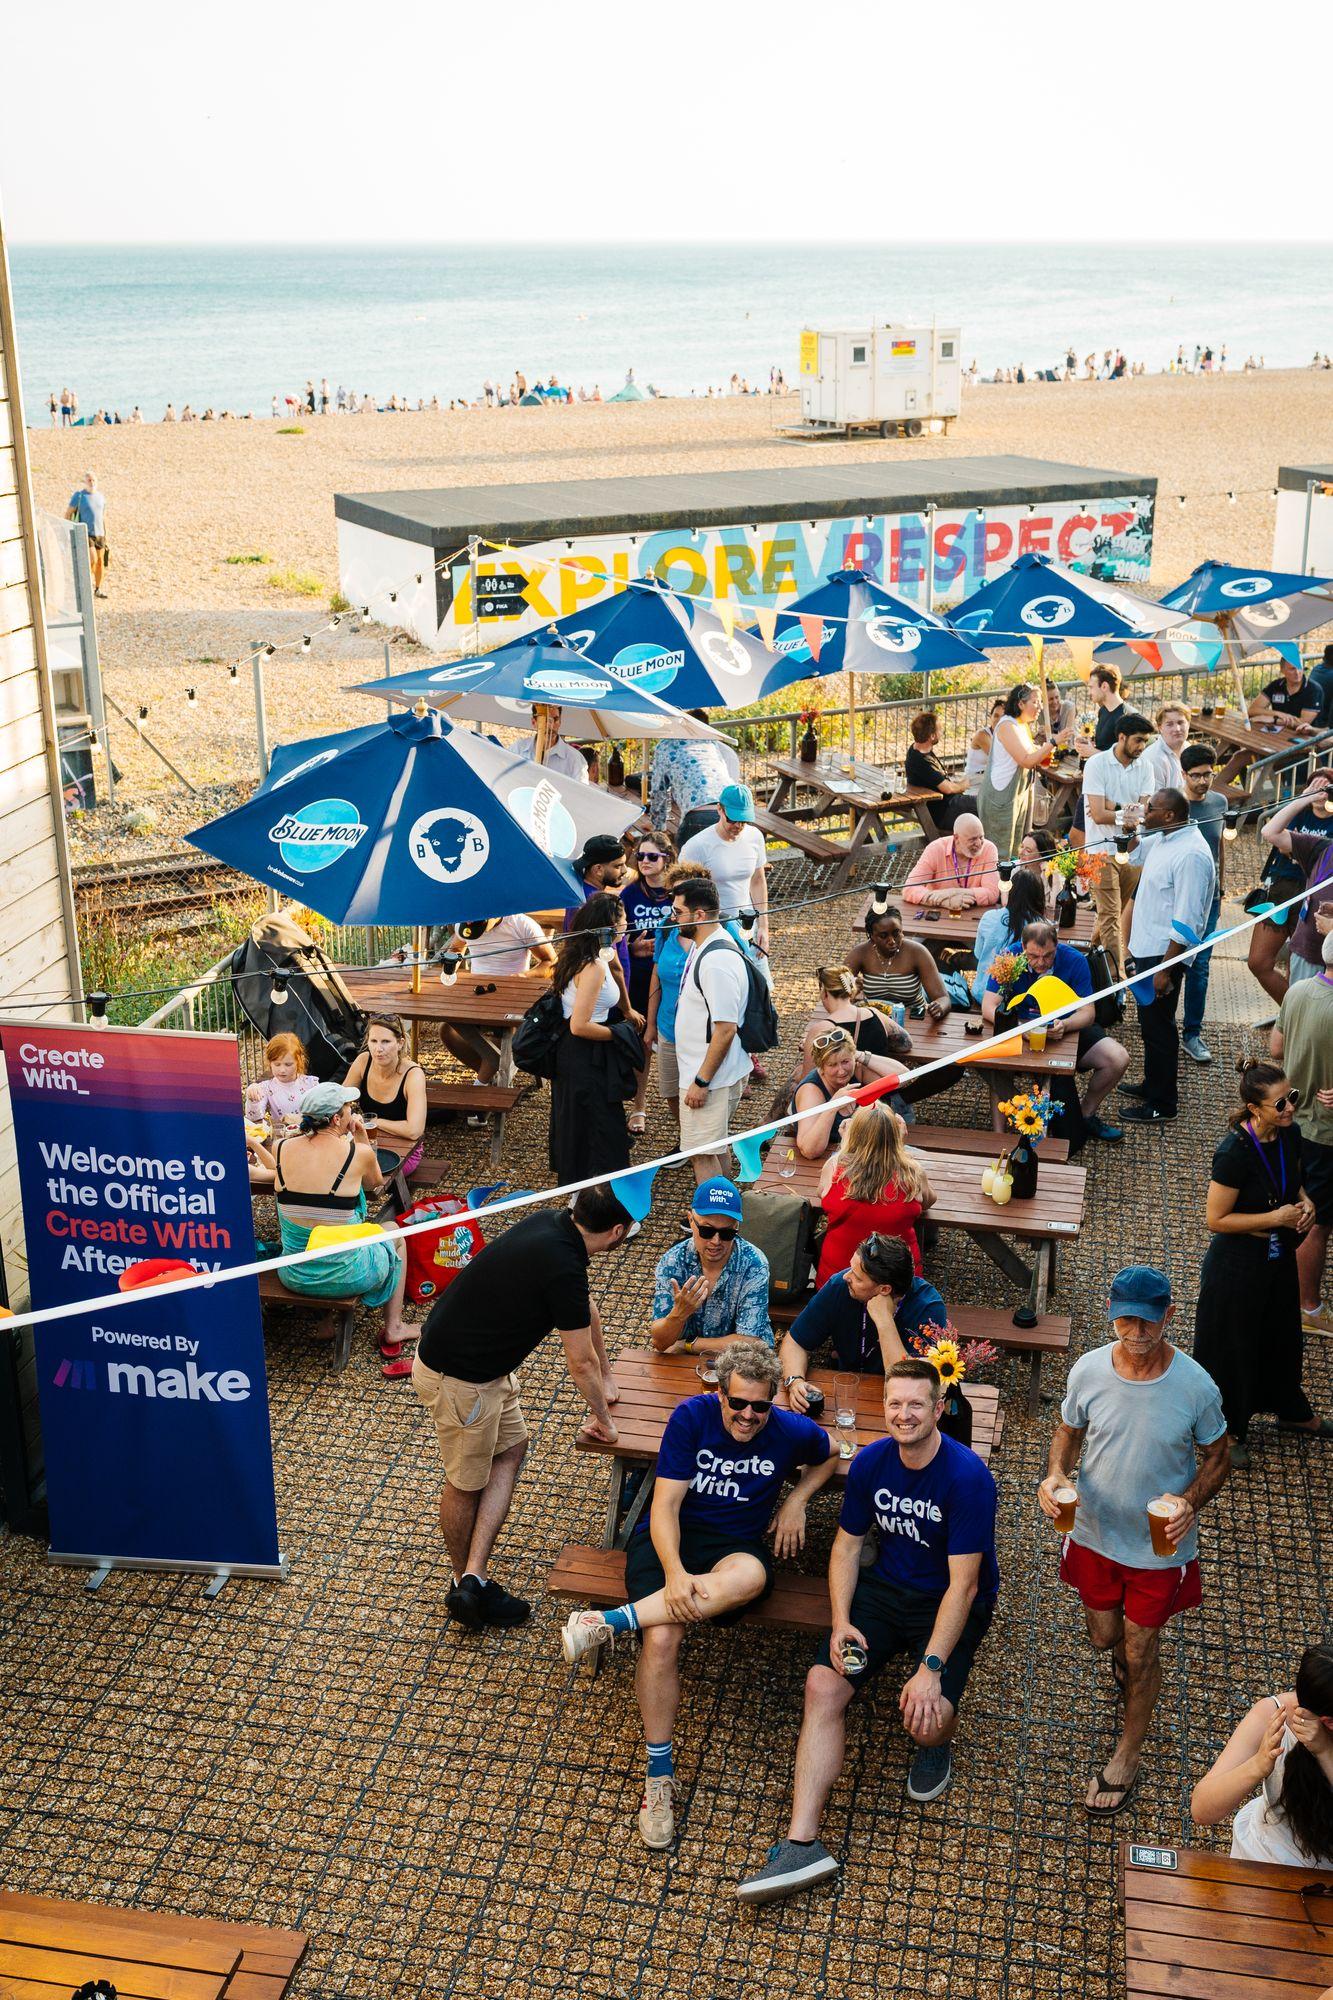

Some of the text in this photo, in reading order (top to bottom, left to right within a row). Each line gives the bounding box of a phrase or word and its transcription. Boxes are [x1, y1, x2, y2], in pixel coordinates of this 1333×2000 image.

[842, 511, 1135, 585] RESPECT
[646, 653, 682, 672] MOON
[569, 681, 609, 689] MOON
[532, 784, 556, 826] MOON
[272, 818, 364, 843] BLUE MOON
[418, 837, 484, 859] B B
[633, 904, 672, 917] Crea
[20, 1043, 105, 1069] Create
[22, 1067, 90, 1095] With_
[38, 1141, 226, 1182] Welcome to
[47, 1177, 216, 1215] the Official
[709, 1188, 734, 1198] Create
[46, 1209, 232, 1249] Create With
[61, 1244, 221, 1288] Afterty
[91, 1325, 200, 1356] Powered By
[107, 1361, 251, 1402] make
[695, 1449, 775, 1476] Create
[874, 1487, 943, 1523] Create
